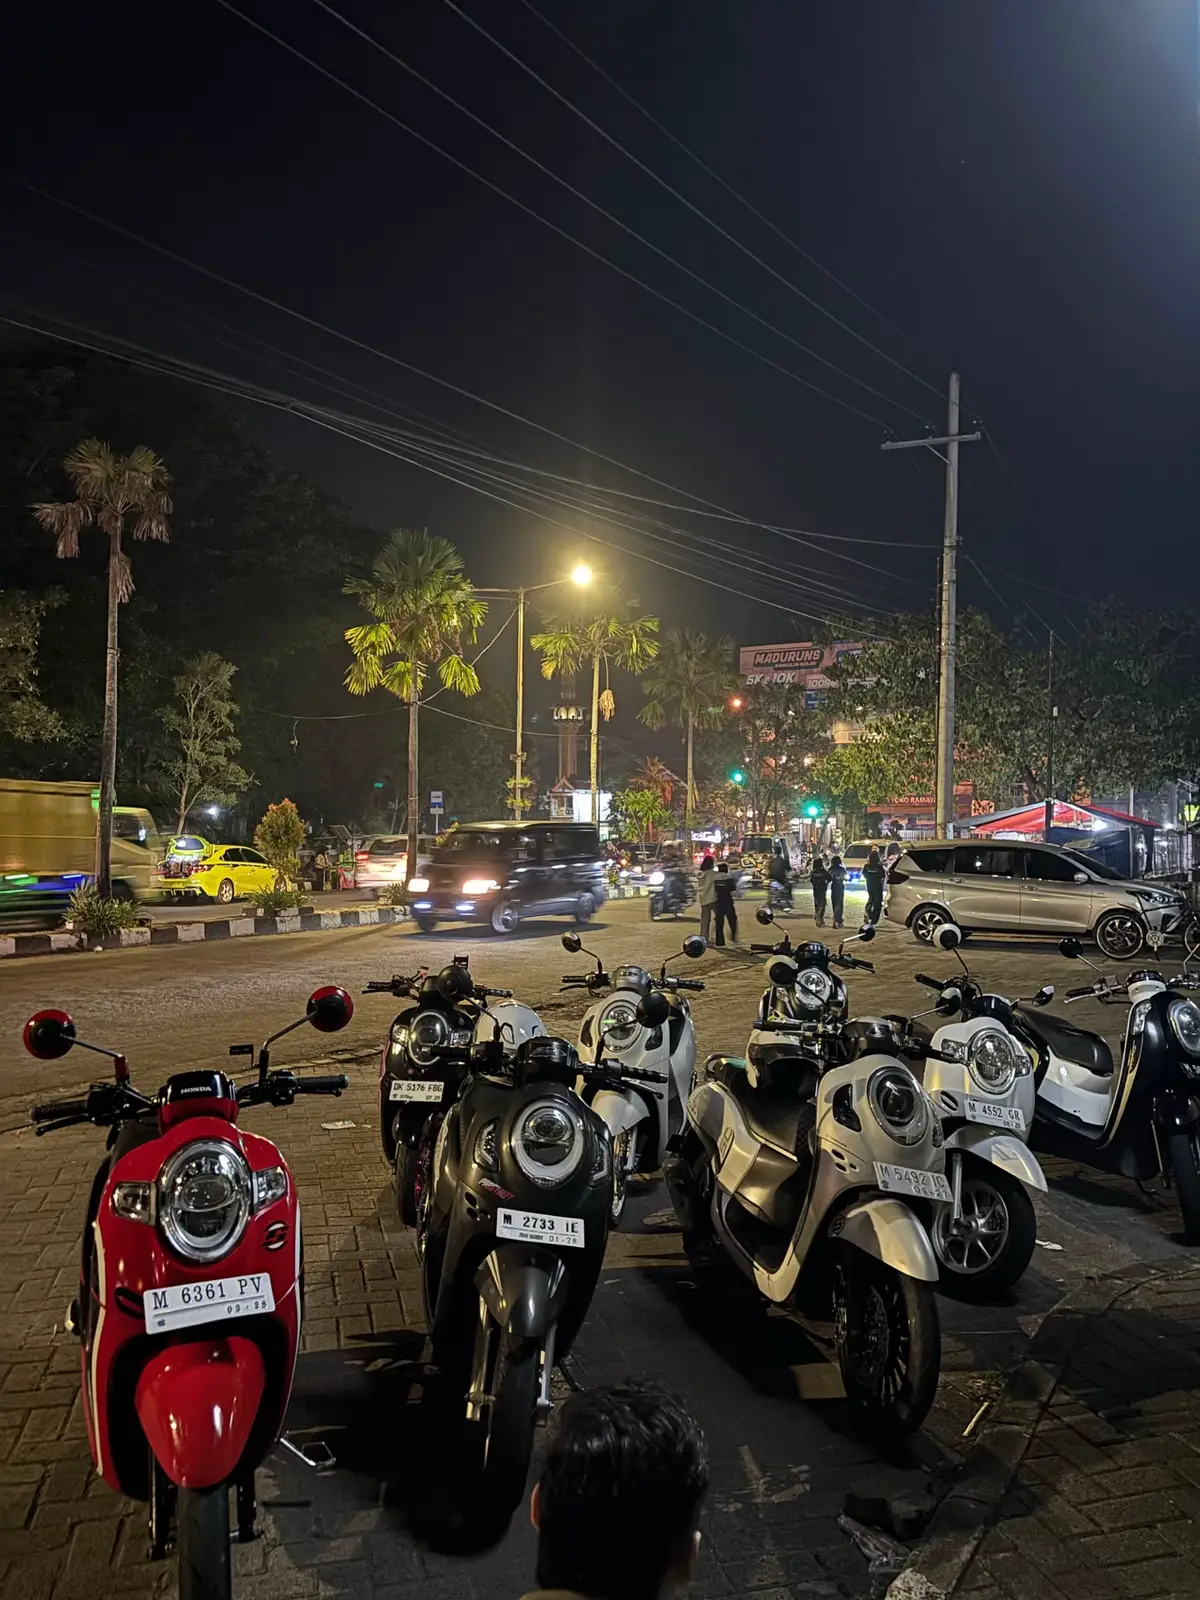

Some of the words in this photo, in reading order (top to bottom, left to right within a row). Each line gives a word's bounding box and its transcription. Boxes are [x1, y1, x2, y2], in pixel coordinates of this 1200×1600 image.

[754, 649, 821, 664] MADURUNS
[745, 674, 764, 685] 5K
[772, 672, 796, 684] 10K
[180, 1086, 213, 1095] HONDA
[393, 1082, 404, 1091] DK
[406, 1083, 425, 1092] 5176
[968, 1101, 977, 1113] M
[981, 1104, 1004, 1118] 4552
[879, 1163, 891, 1179] M
[893, 1167, 928, 1186] 5492
[502, 1213, 513, 1226] M
[522, 1215, 556, 1232] 2733
[565, 1221, 579, 1234] IE
[152, 1291, 170, 1310] M
[180, 1282, 227, 1305] 6361
[237, 1276, 262, 1296] PV
